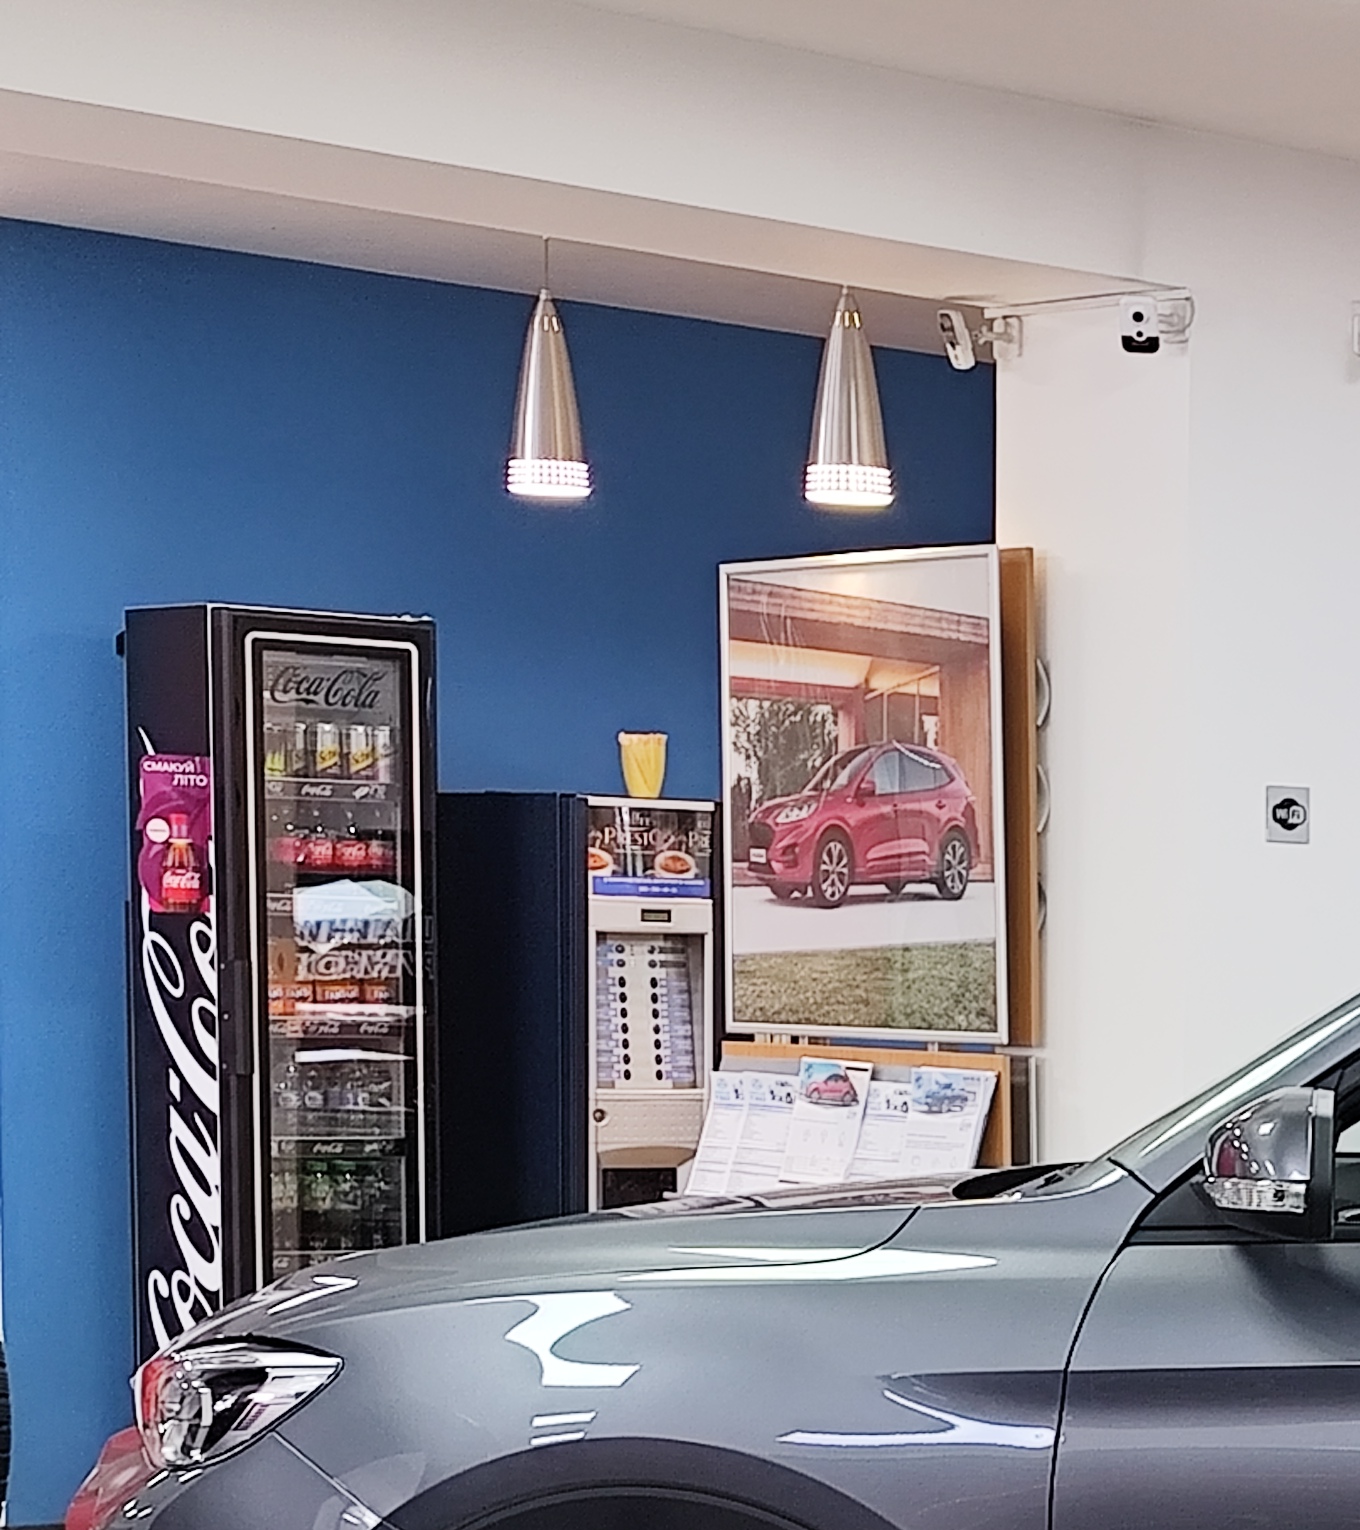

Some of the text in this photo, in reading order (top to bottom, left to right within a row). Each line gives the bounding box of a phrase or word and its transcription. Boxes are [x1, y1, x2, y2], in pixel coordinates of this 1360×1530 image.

[270, 665, 387, 709] Coca-Cola
[142, 760, 195, 773] СМАКУЙ
[172, 774, 208, 787] ЛІТО
